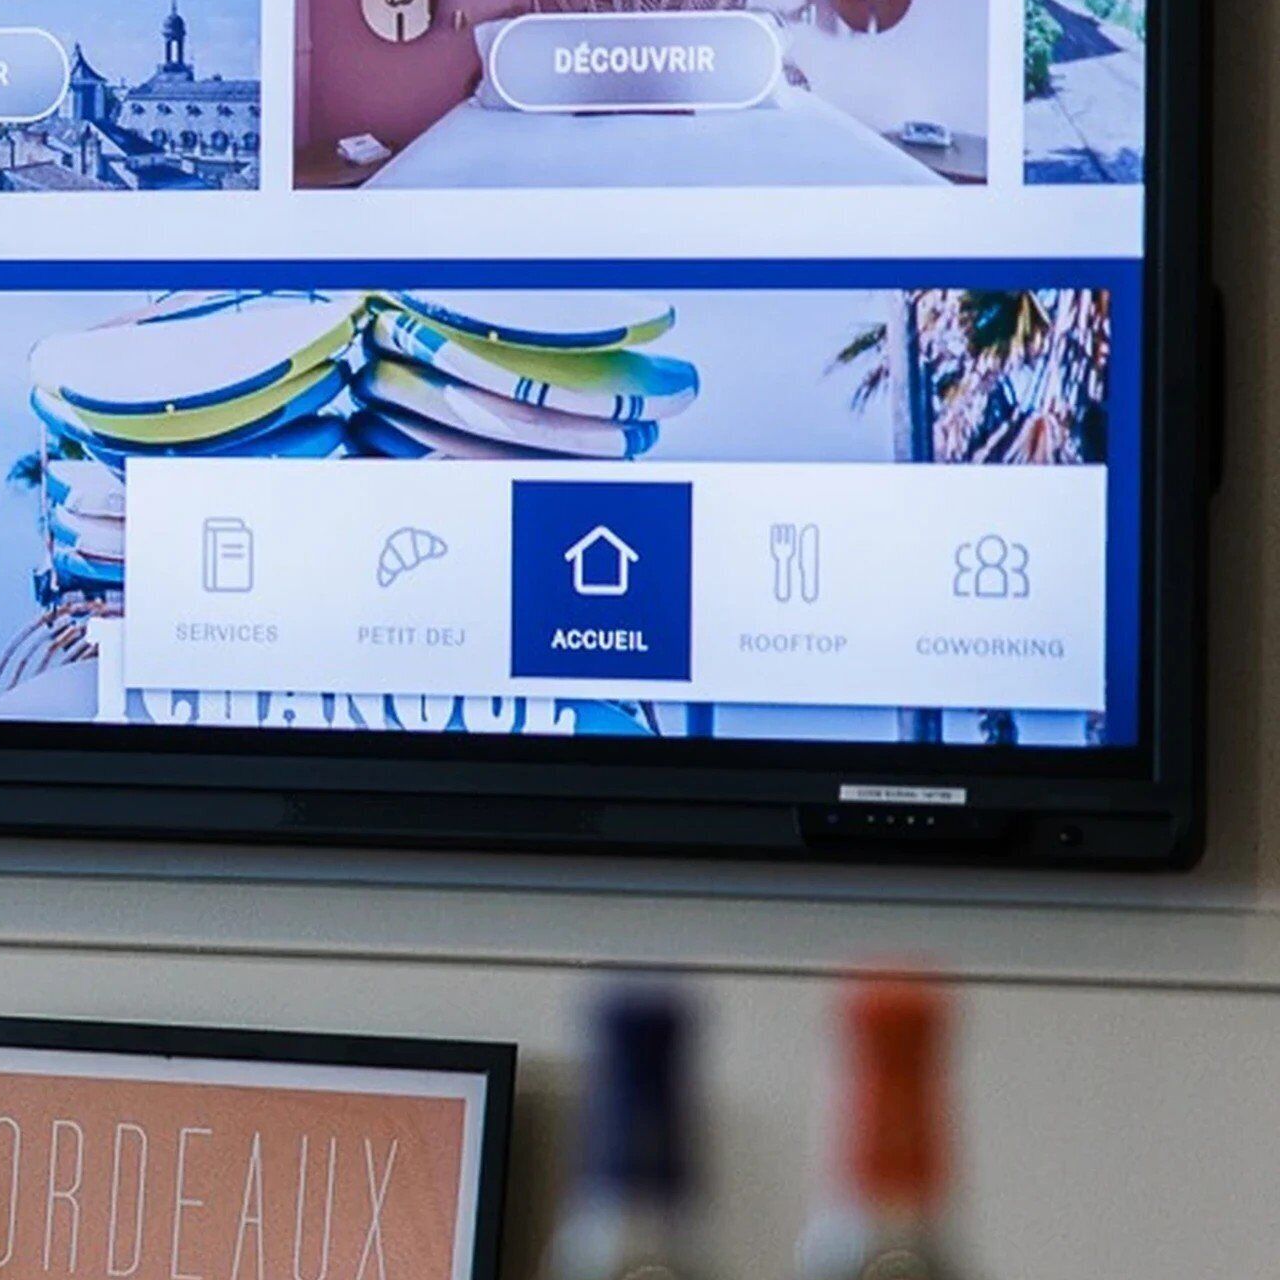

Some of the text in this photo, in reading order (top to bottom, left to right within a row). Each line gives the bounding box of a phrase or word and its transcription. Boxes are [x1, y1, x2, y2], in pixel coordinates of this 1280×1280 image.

[554, 42, 716, 74] DÉCOUVRIR
[176, 623, 278, 643] SERVICES
[358, 626, 465, 647] PETIT DEJ
[551, 629, 648, 651] ACCUEIL
[739, 633, 847, 654] ROOFTOP
[917, 637, 1065, 658] COWORKING
